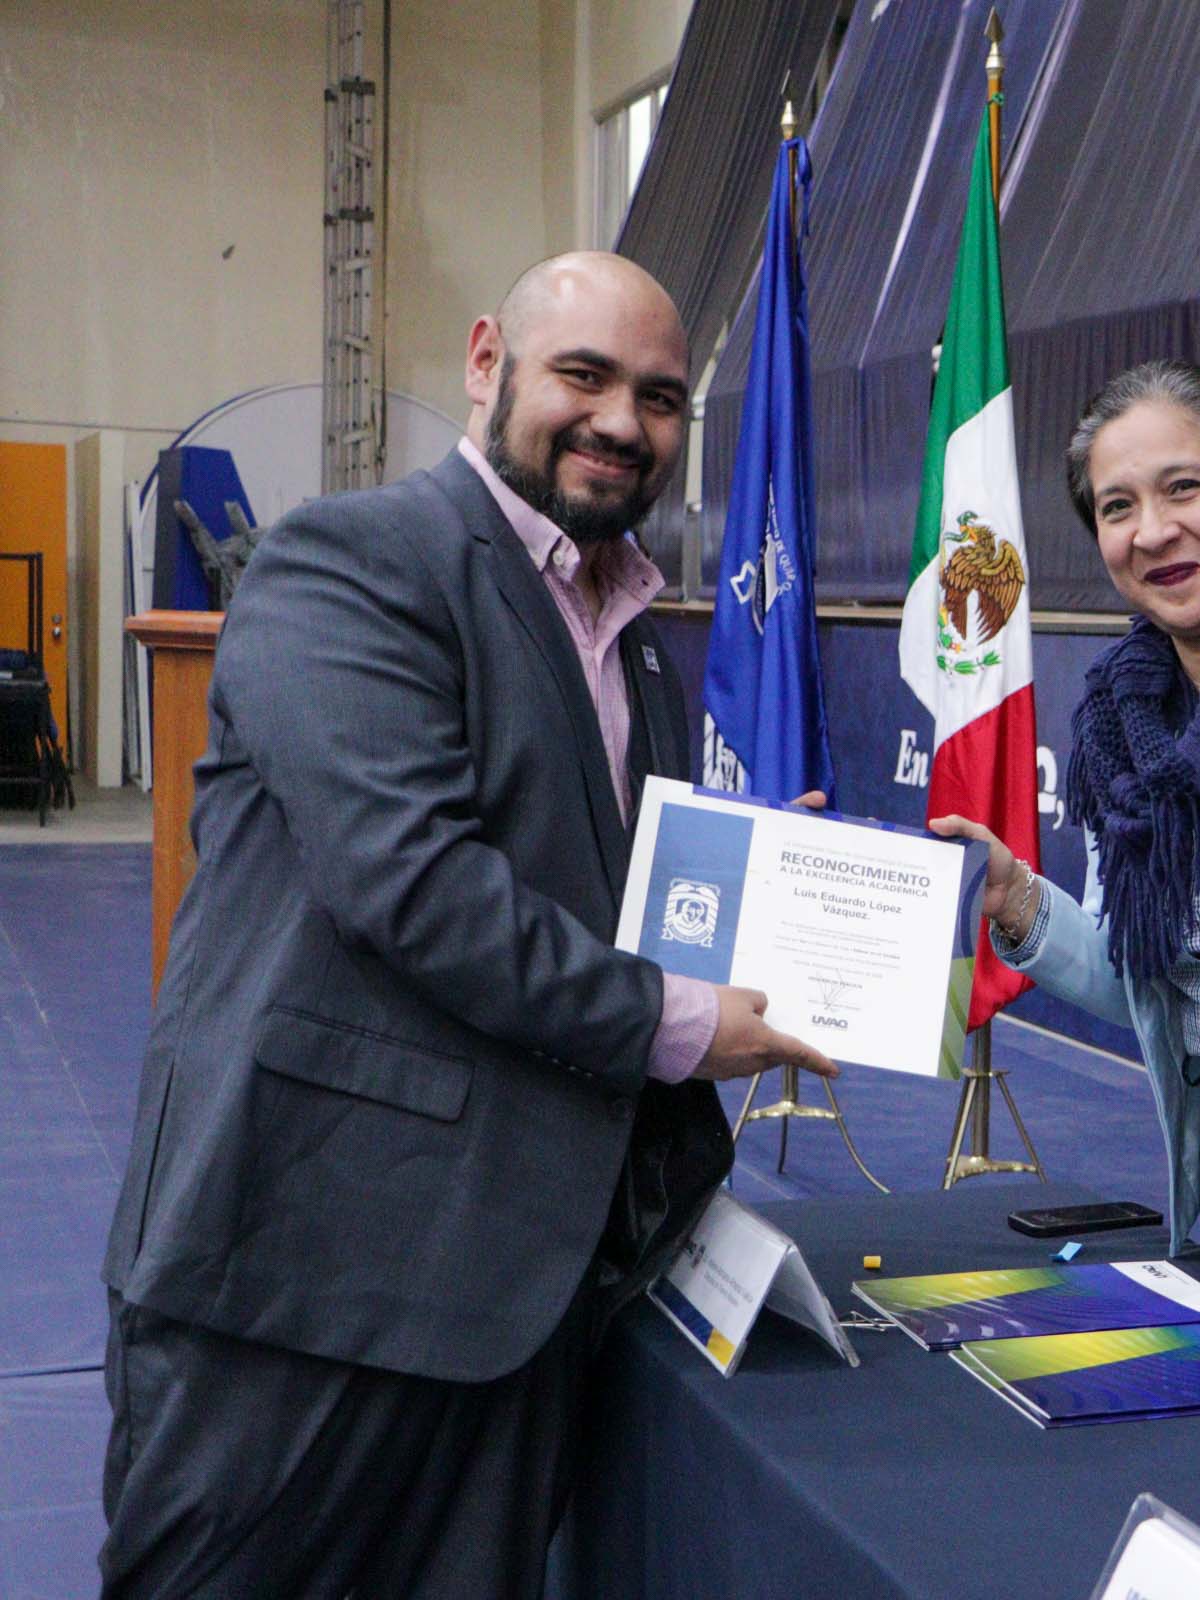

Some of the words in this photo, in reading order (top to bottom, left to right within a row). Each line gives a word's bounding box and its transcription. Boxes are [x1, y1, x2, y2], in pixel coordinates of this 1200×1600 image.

[780, 851, 931, 888] RECONOCIMIENTO
[790, 866, 803, 876] LA
[805, 869, 866, 887] EXCELENCIA
[793, 887, 817, 900] Luis
[820, 891, 866, 908] Eduardo
[869, 900, 902, 915] López
[811, 1015, 848, 1028] UVAQ
